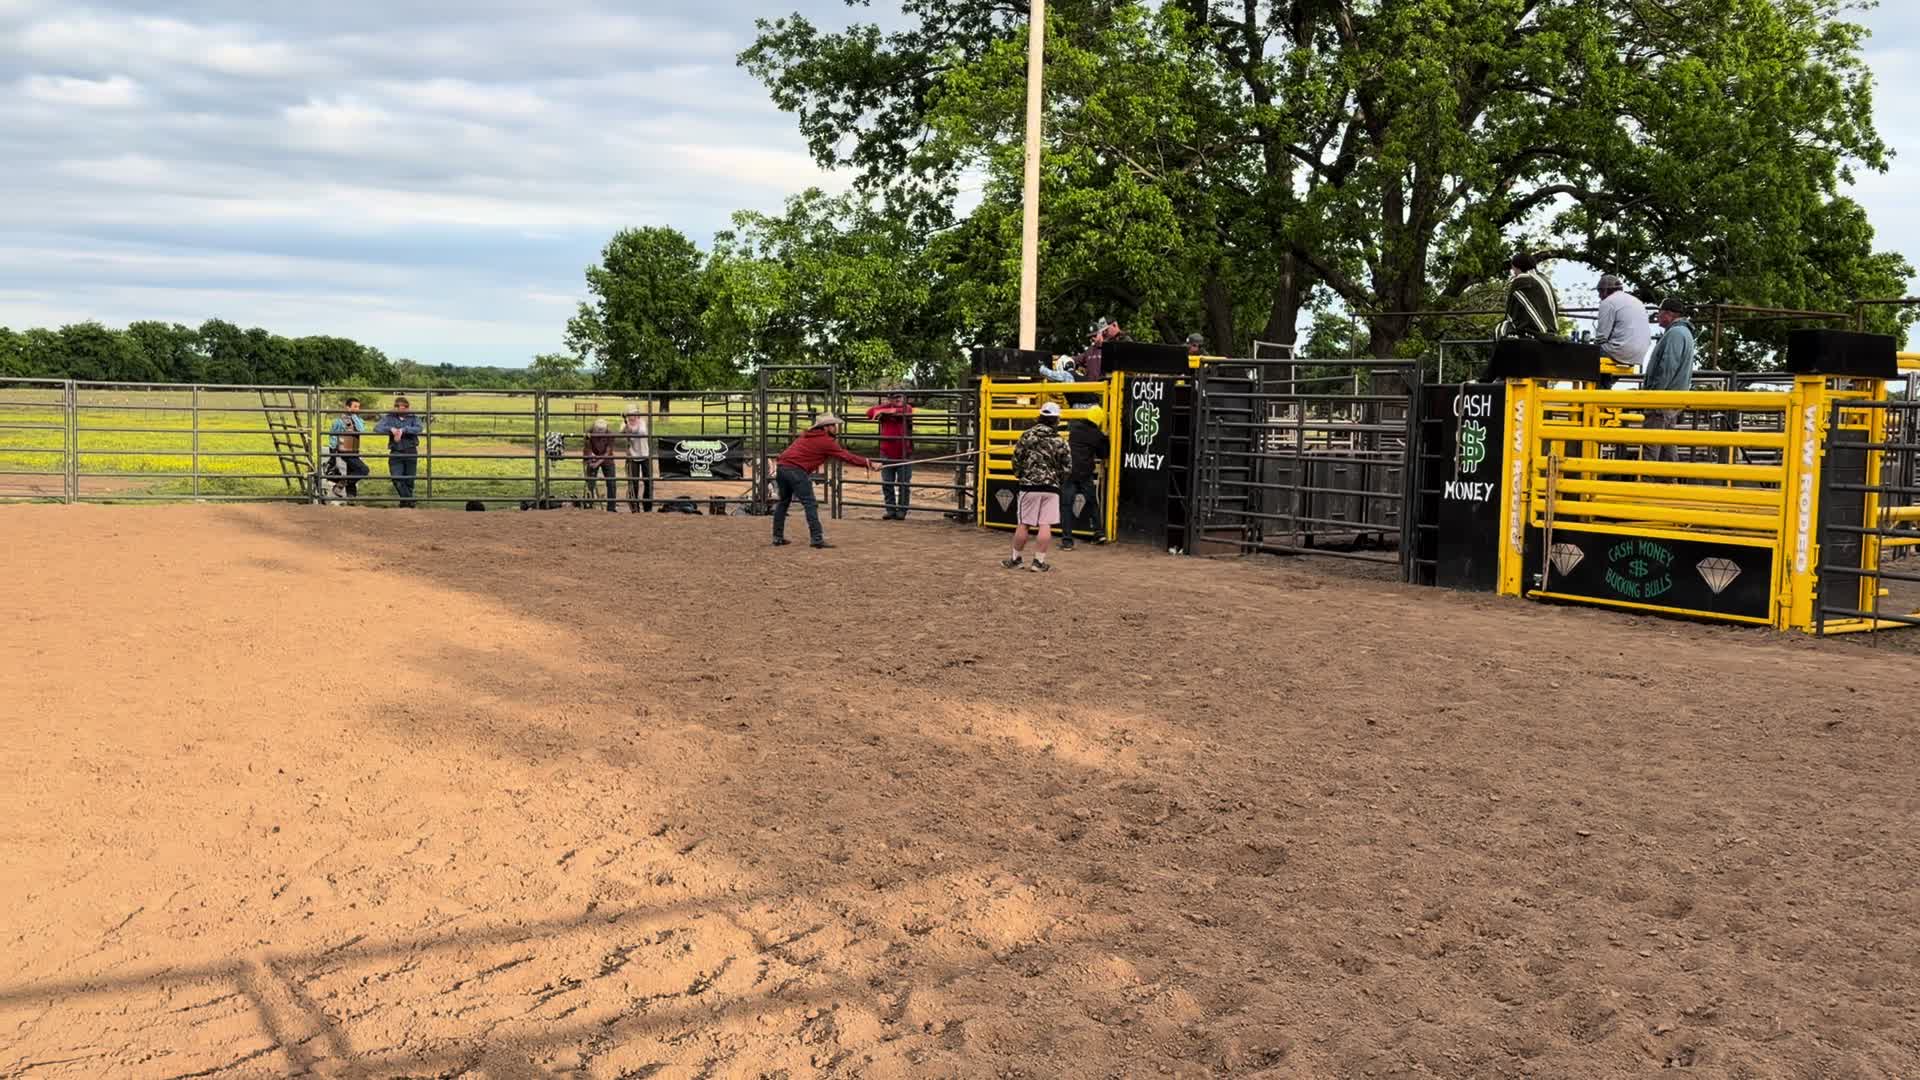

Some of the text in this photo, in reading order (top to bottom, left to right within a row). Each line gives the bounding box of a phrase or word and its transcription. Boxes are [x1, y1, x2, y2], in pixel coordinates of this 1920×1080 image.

[1133, 381, 1164, 400] CASH
[1453, 394, 1492, 417] CASH
[1124, 452, 1164, 471] MONEY
[1444, 480, 1494, 502] MONEY
[1608, 540, 1675, 568] CASH MONEY
[1605, 567, 1673, 598] BUCKING BULLS
